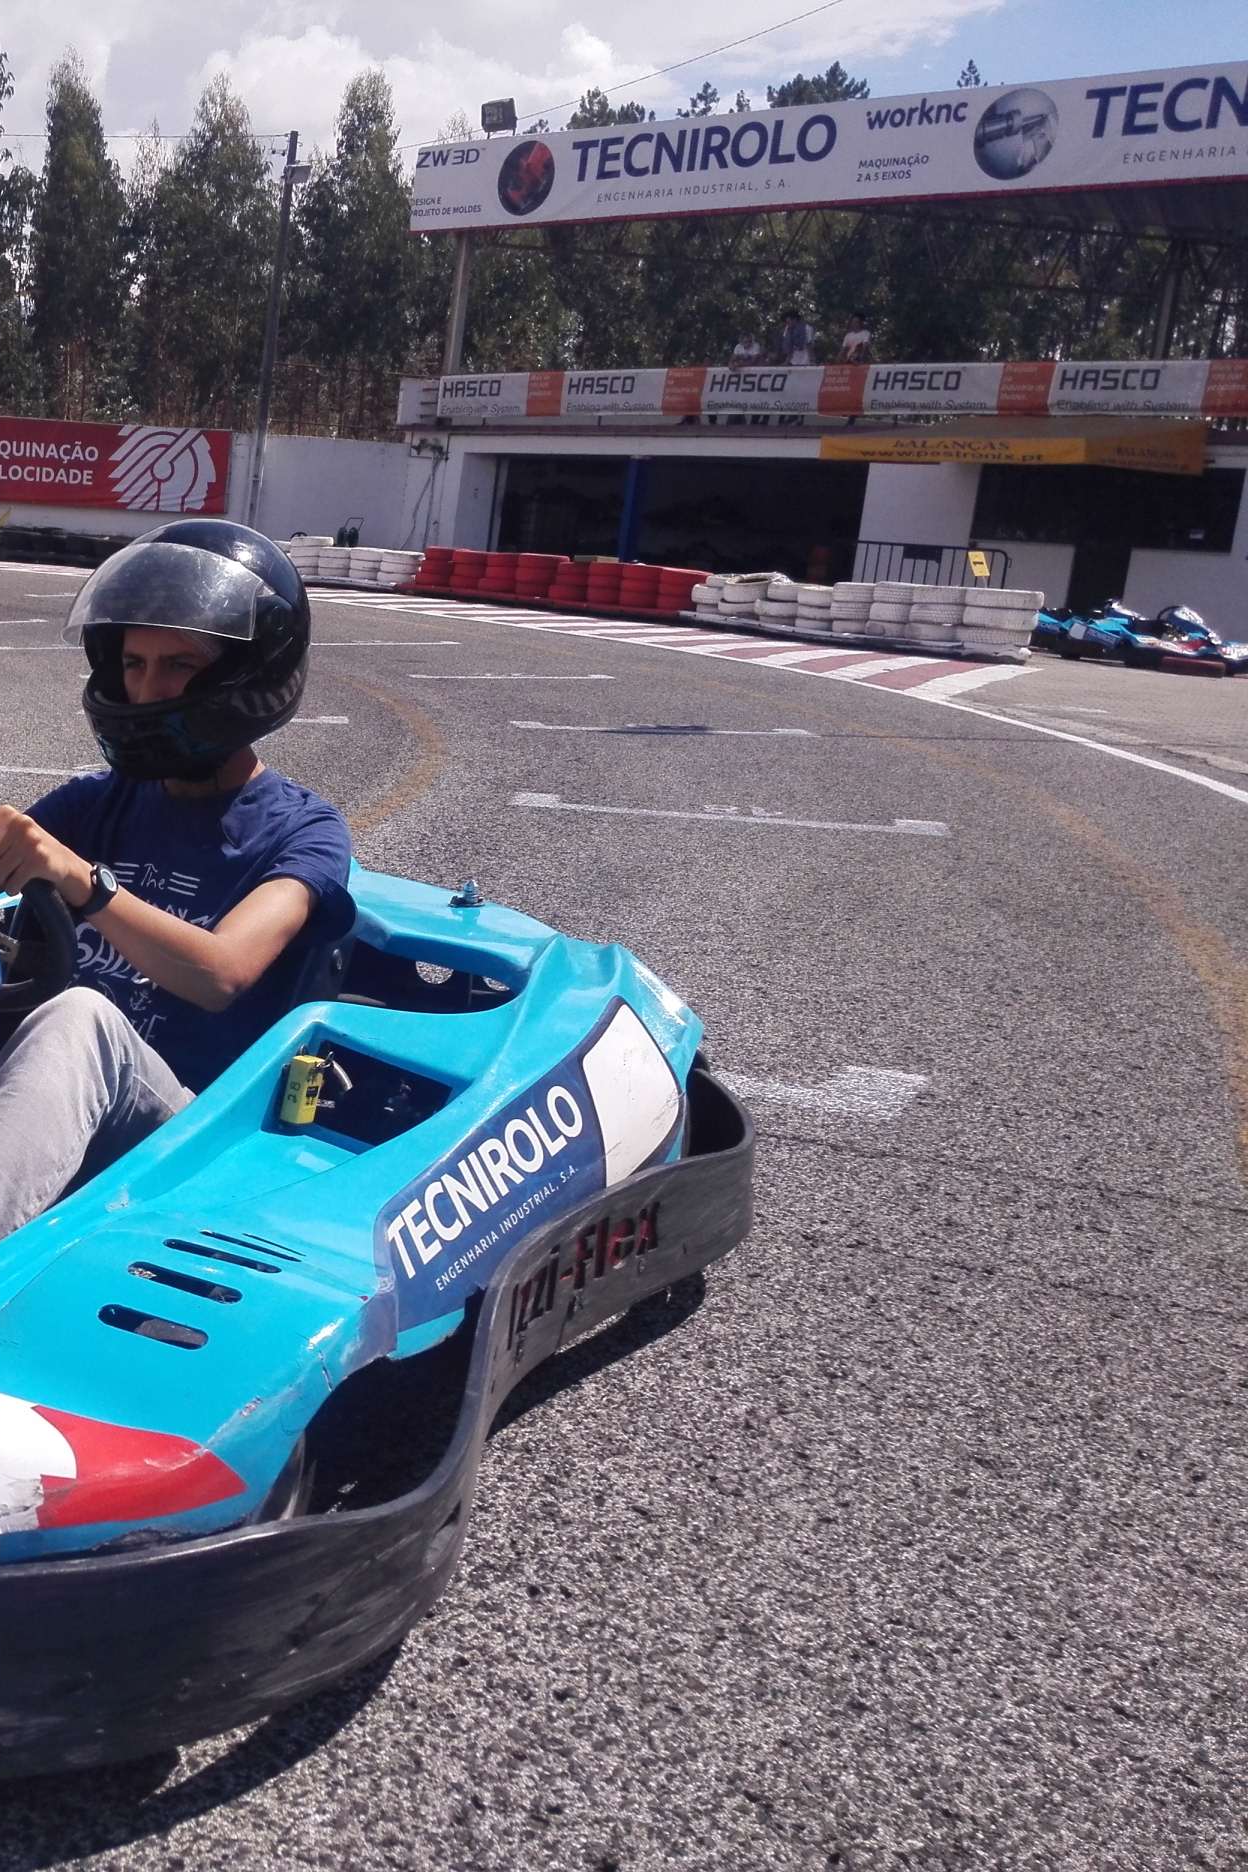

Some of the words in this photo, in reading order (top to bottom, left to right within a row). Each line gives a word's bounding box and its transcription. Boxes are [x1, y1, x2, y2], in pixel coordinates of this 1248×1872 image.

[866, 98, 968, 130] worknc
[1085, 76, 1248, 138] TECN
[416, 148, 480, 168] ZW3D
[571, 114, 838, 182] TECNIROLO
[1123, 146, 1237, 164] ENGENHARIA
[858, 153, 930, 169] MAQUINAÇÃO
[882, 169, 912, 181] EIXOS
[597, 187, 674, 203] ENGENHARIA
[452, 204, 482, 214] MOLDES
[443, 380, 502, 398] HASCO
[568, 376, 636, 395] HASCO
[709, 373, 789, 393] HASCO
[872, 371, 962, 391] HASCO
[1059, 368, 1162, 391] HASCO
[140, 863, 166, 890] The
[385, 1085, 584, 1280] TECNIROLO
[435, 1230, 500, 1291] ENGENHARIA
